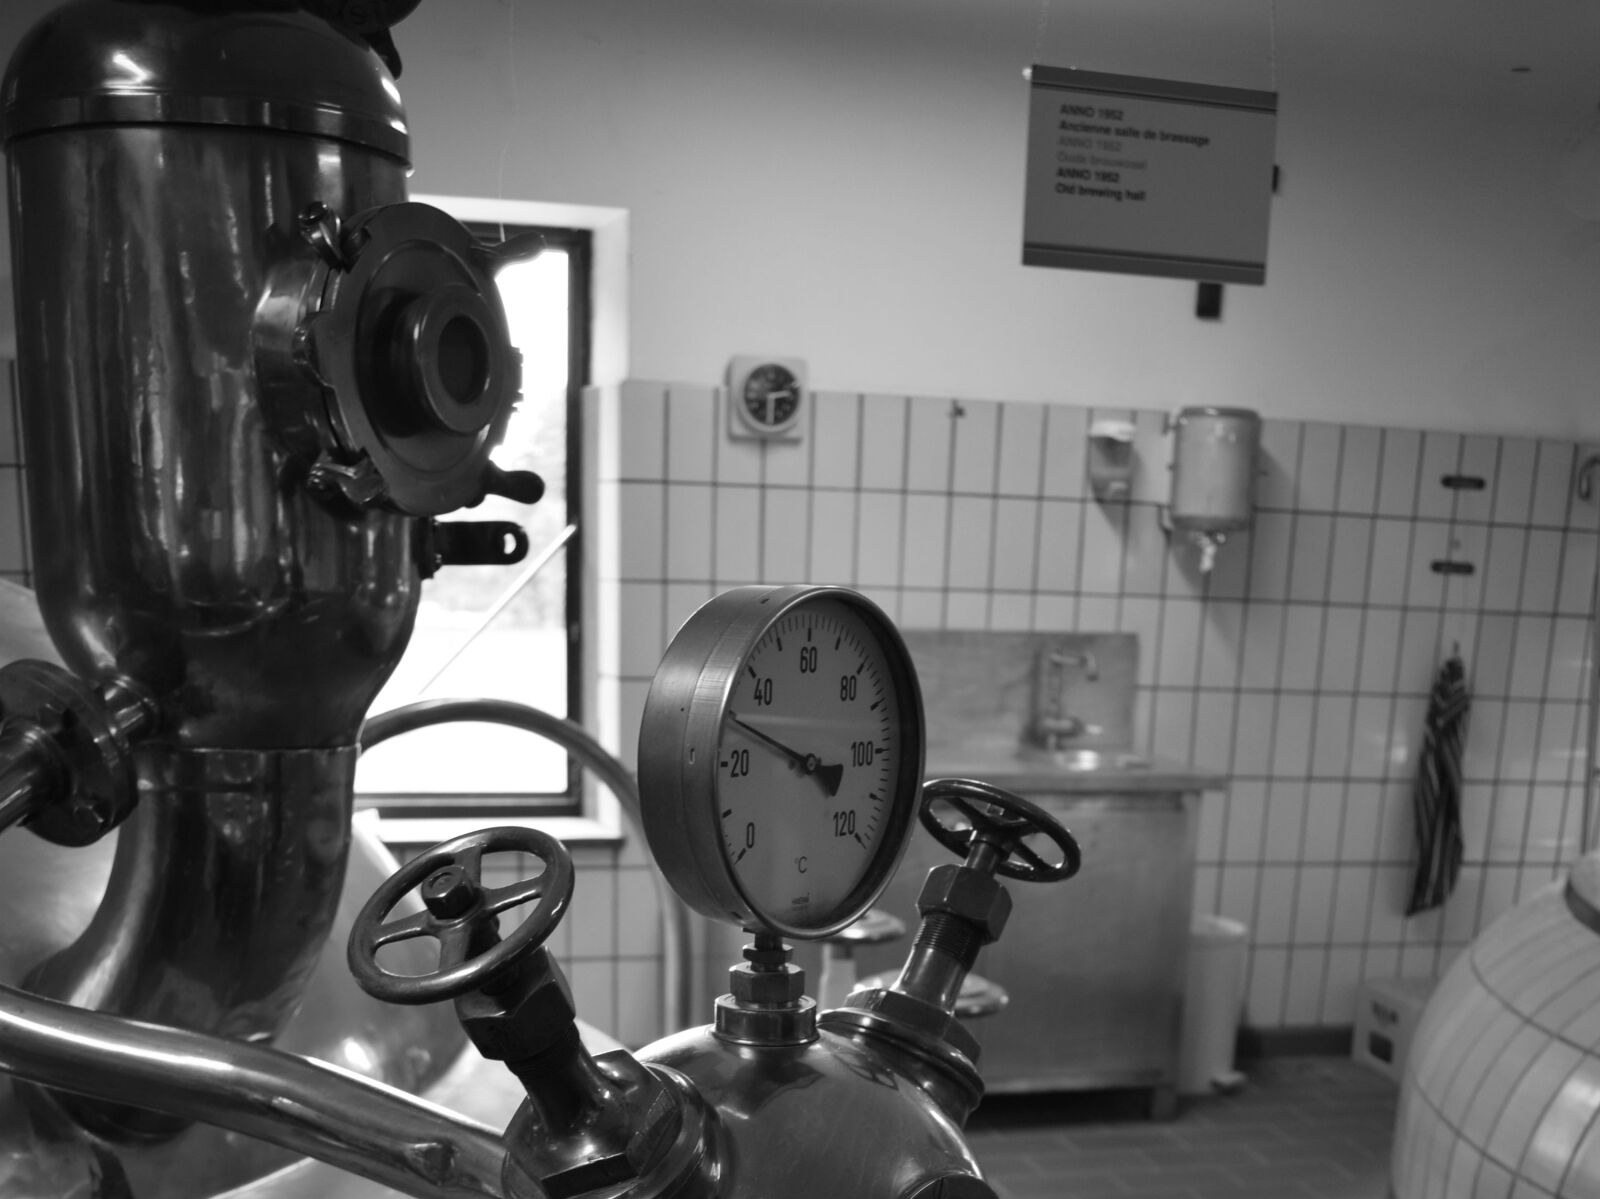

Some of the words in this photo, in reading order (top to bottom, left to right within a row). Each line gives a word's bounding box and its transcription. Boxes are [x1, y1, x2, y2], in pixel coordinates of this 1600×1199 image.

[1058, 119, 1111, 135] Ancienne
[1114, 126, 1141, 138] salle
[1143, 129, 1157, 140] de
[1159, 130, 1211, 147] brassage
[1055, 182, 1076, 195] Old
[1078, 185, 1123, 202] brewing
[1126, 189, 1146, 201] hall
[800, 646, 818, 674] 60
[753, 678, 773, 706] 40
[840, 674, 857, 702] 80
[730, 749, 750, 778] 20
[850, 741, 874, 768] 100
[746, 822, 755, 849] 0
[832, 810, 856, 838] 120
